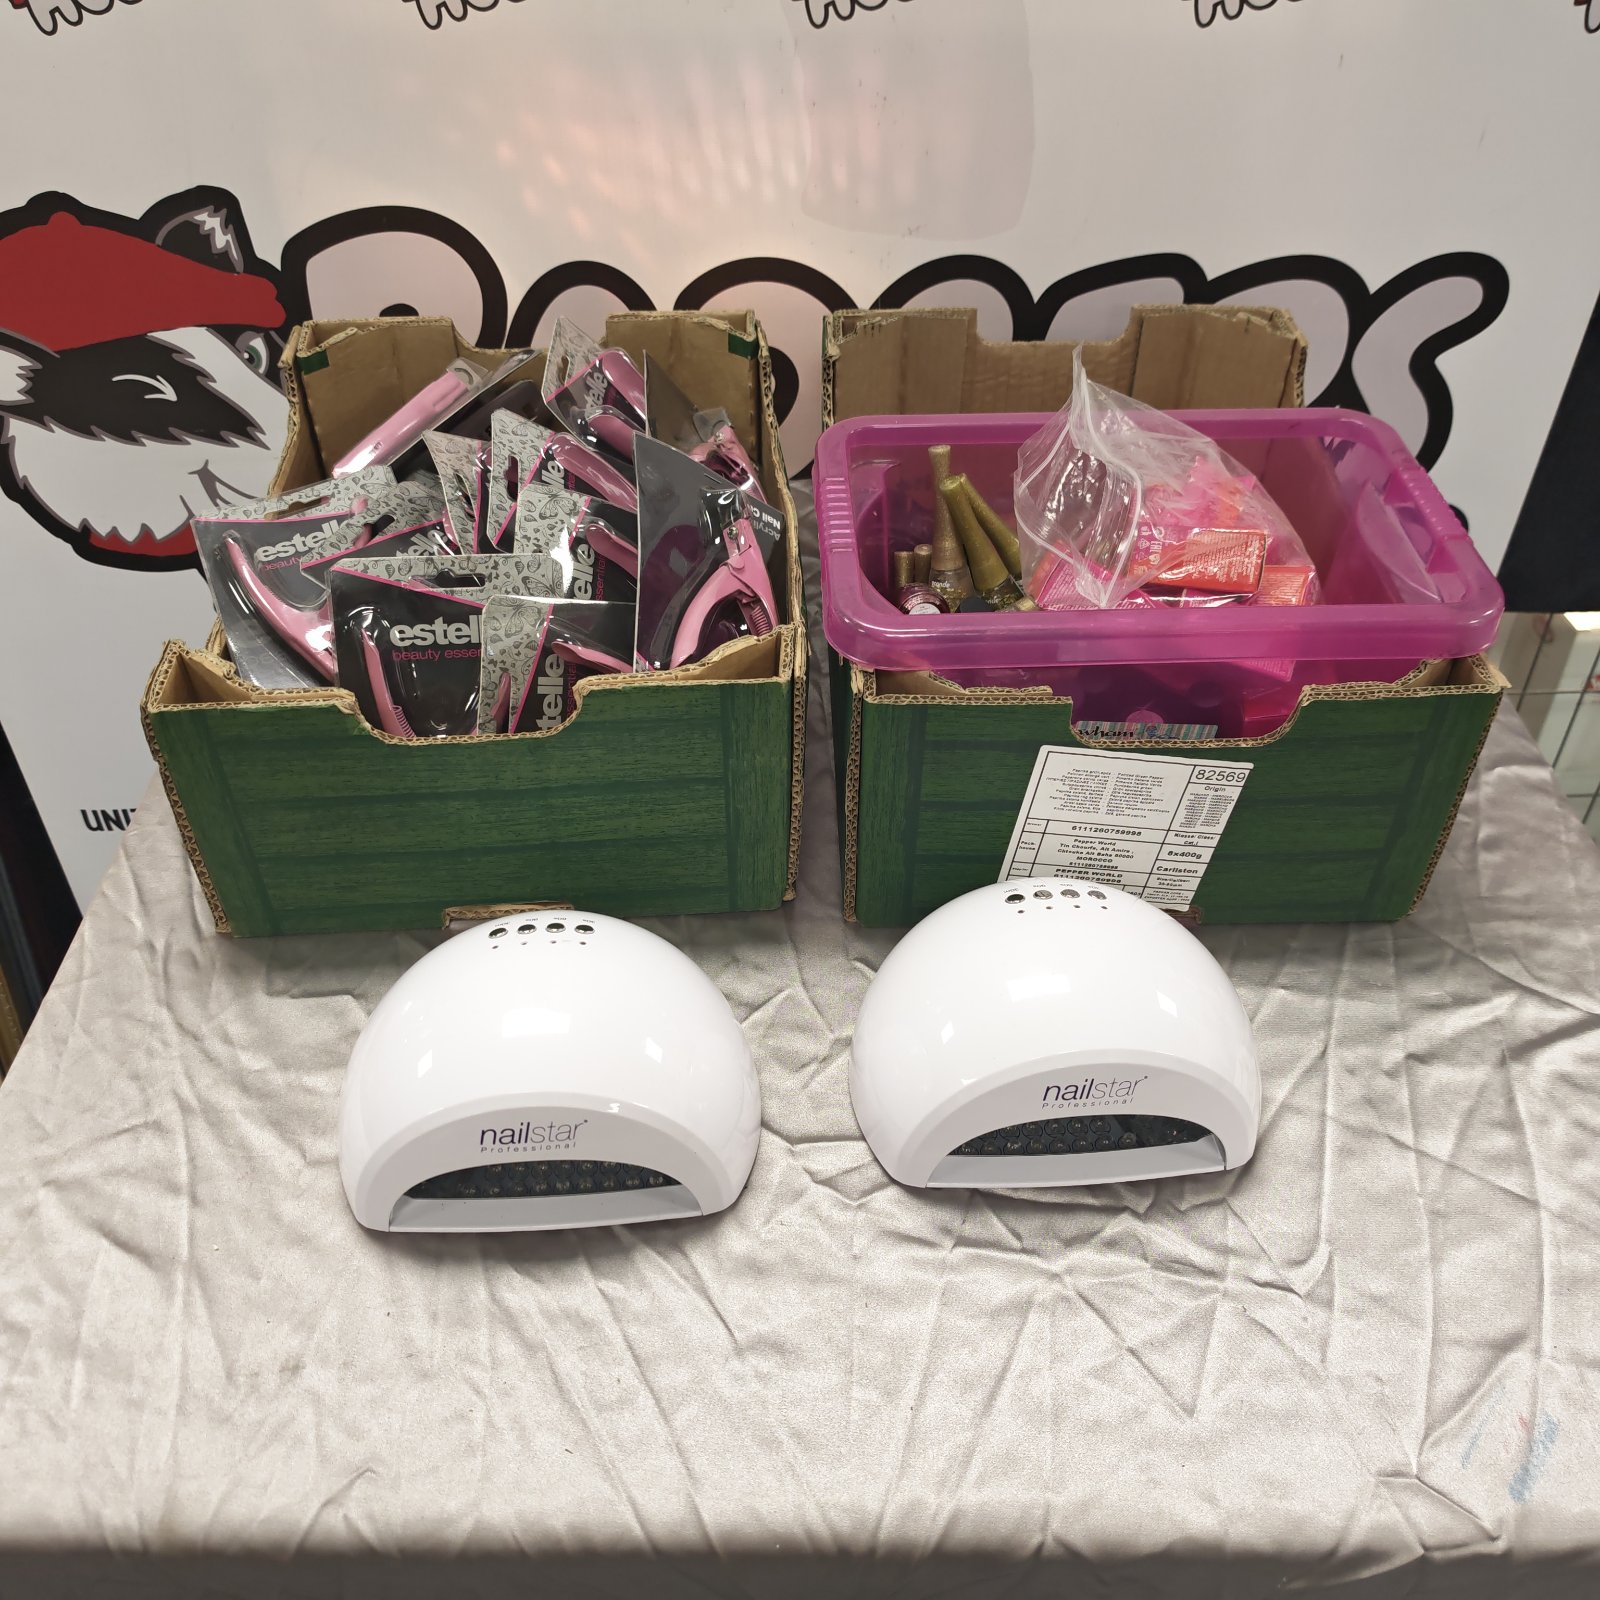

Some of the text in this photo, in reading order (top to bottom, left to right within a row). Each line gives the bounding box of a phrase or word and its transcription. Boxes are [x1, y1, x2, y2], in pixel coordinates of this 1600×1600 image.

[762, 512, 781, 530] Nail
[1195, 769, 1247, 783] 82569
[1042, 1077, 1145, 1102] nailstar
[1041, 1098, 1134, 1110] Professional
[480, 1121, 584, 1146] nailstar
[480, 1142, 577, 1154] Professional
